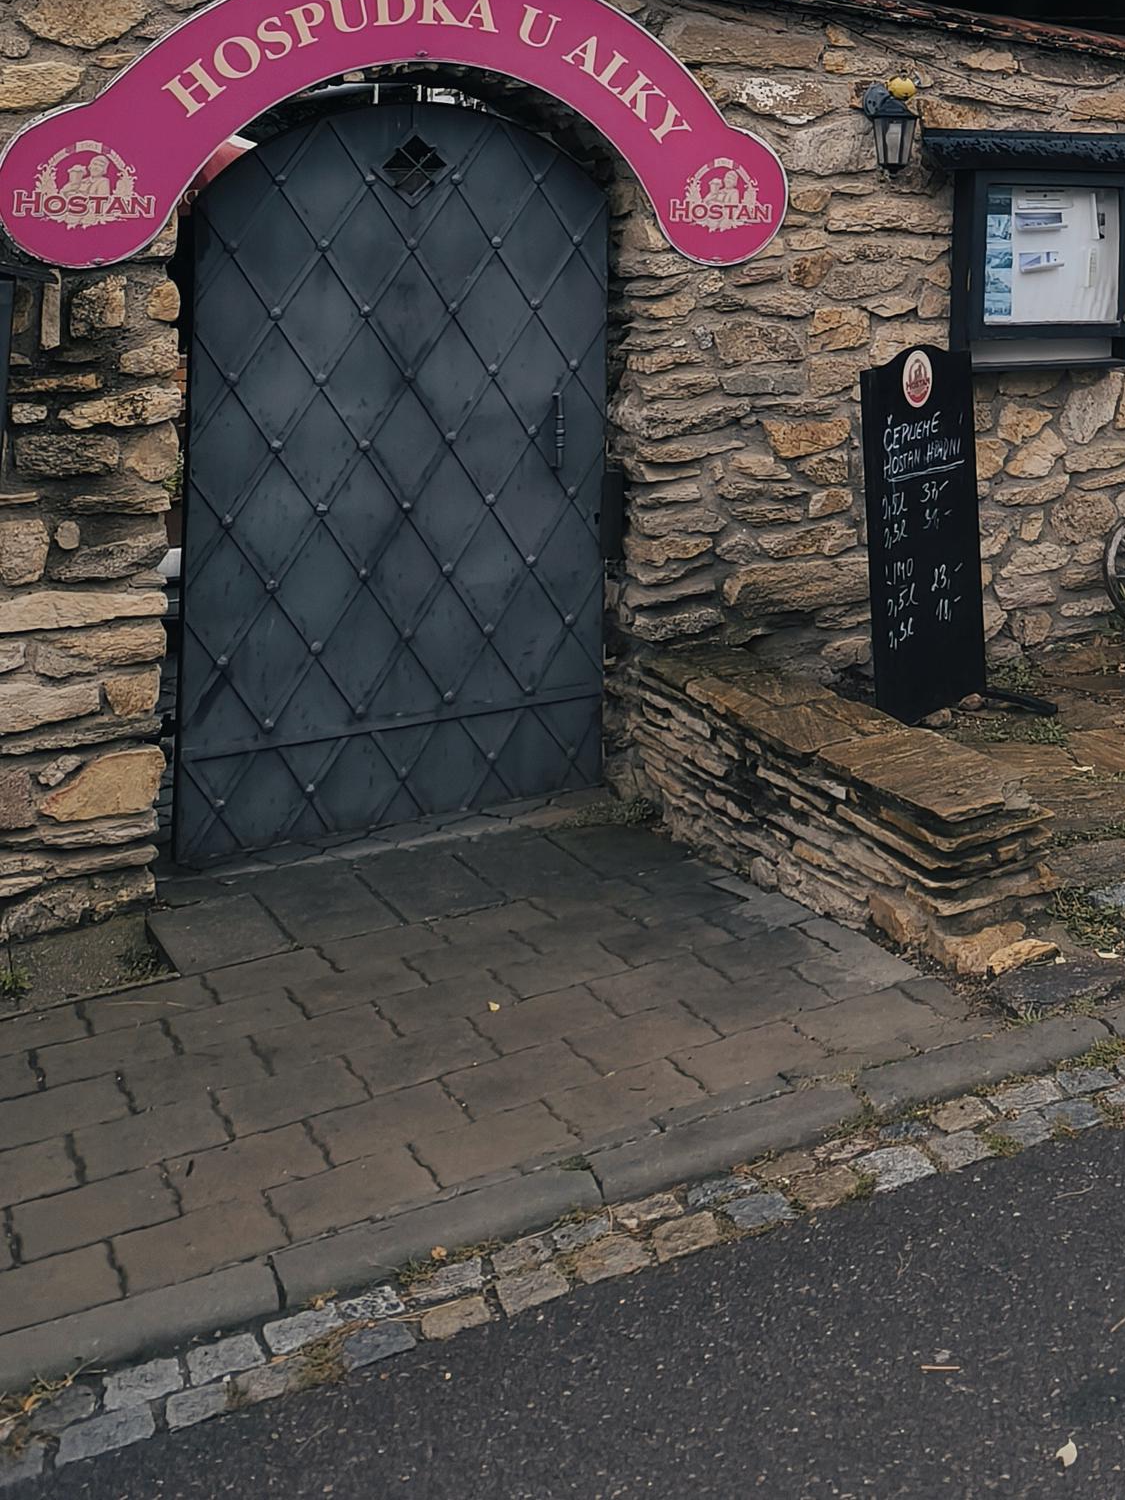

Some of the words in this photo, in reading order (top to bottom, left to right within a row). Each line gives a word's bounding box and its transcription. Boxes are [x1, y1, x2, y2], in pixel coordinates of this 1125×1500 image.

[518, 4, 561, 48] U
[561, 35, 693, 144] ALKY
[13, 189, 156, 219] HOSTAN
[669, 198, 772, 223] HOSTAN
[883, 448, 921, 479] HOSTAN
